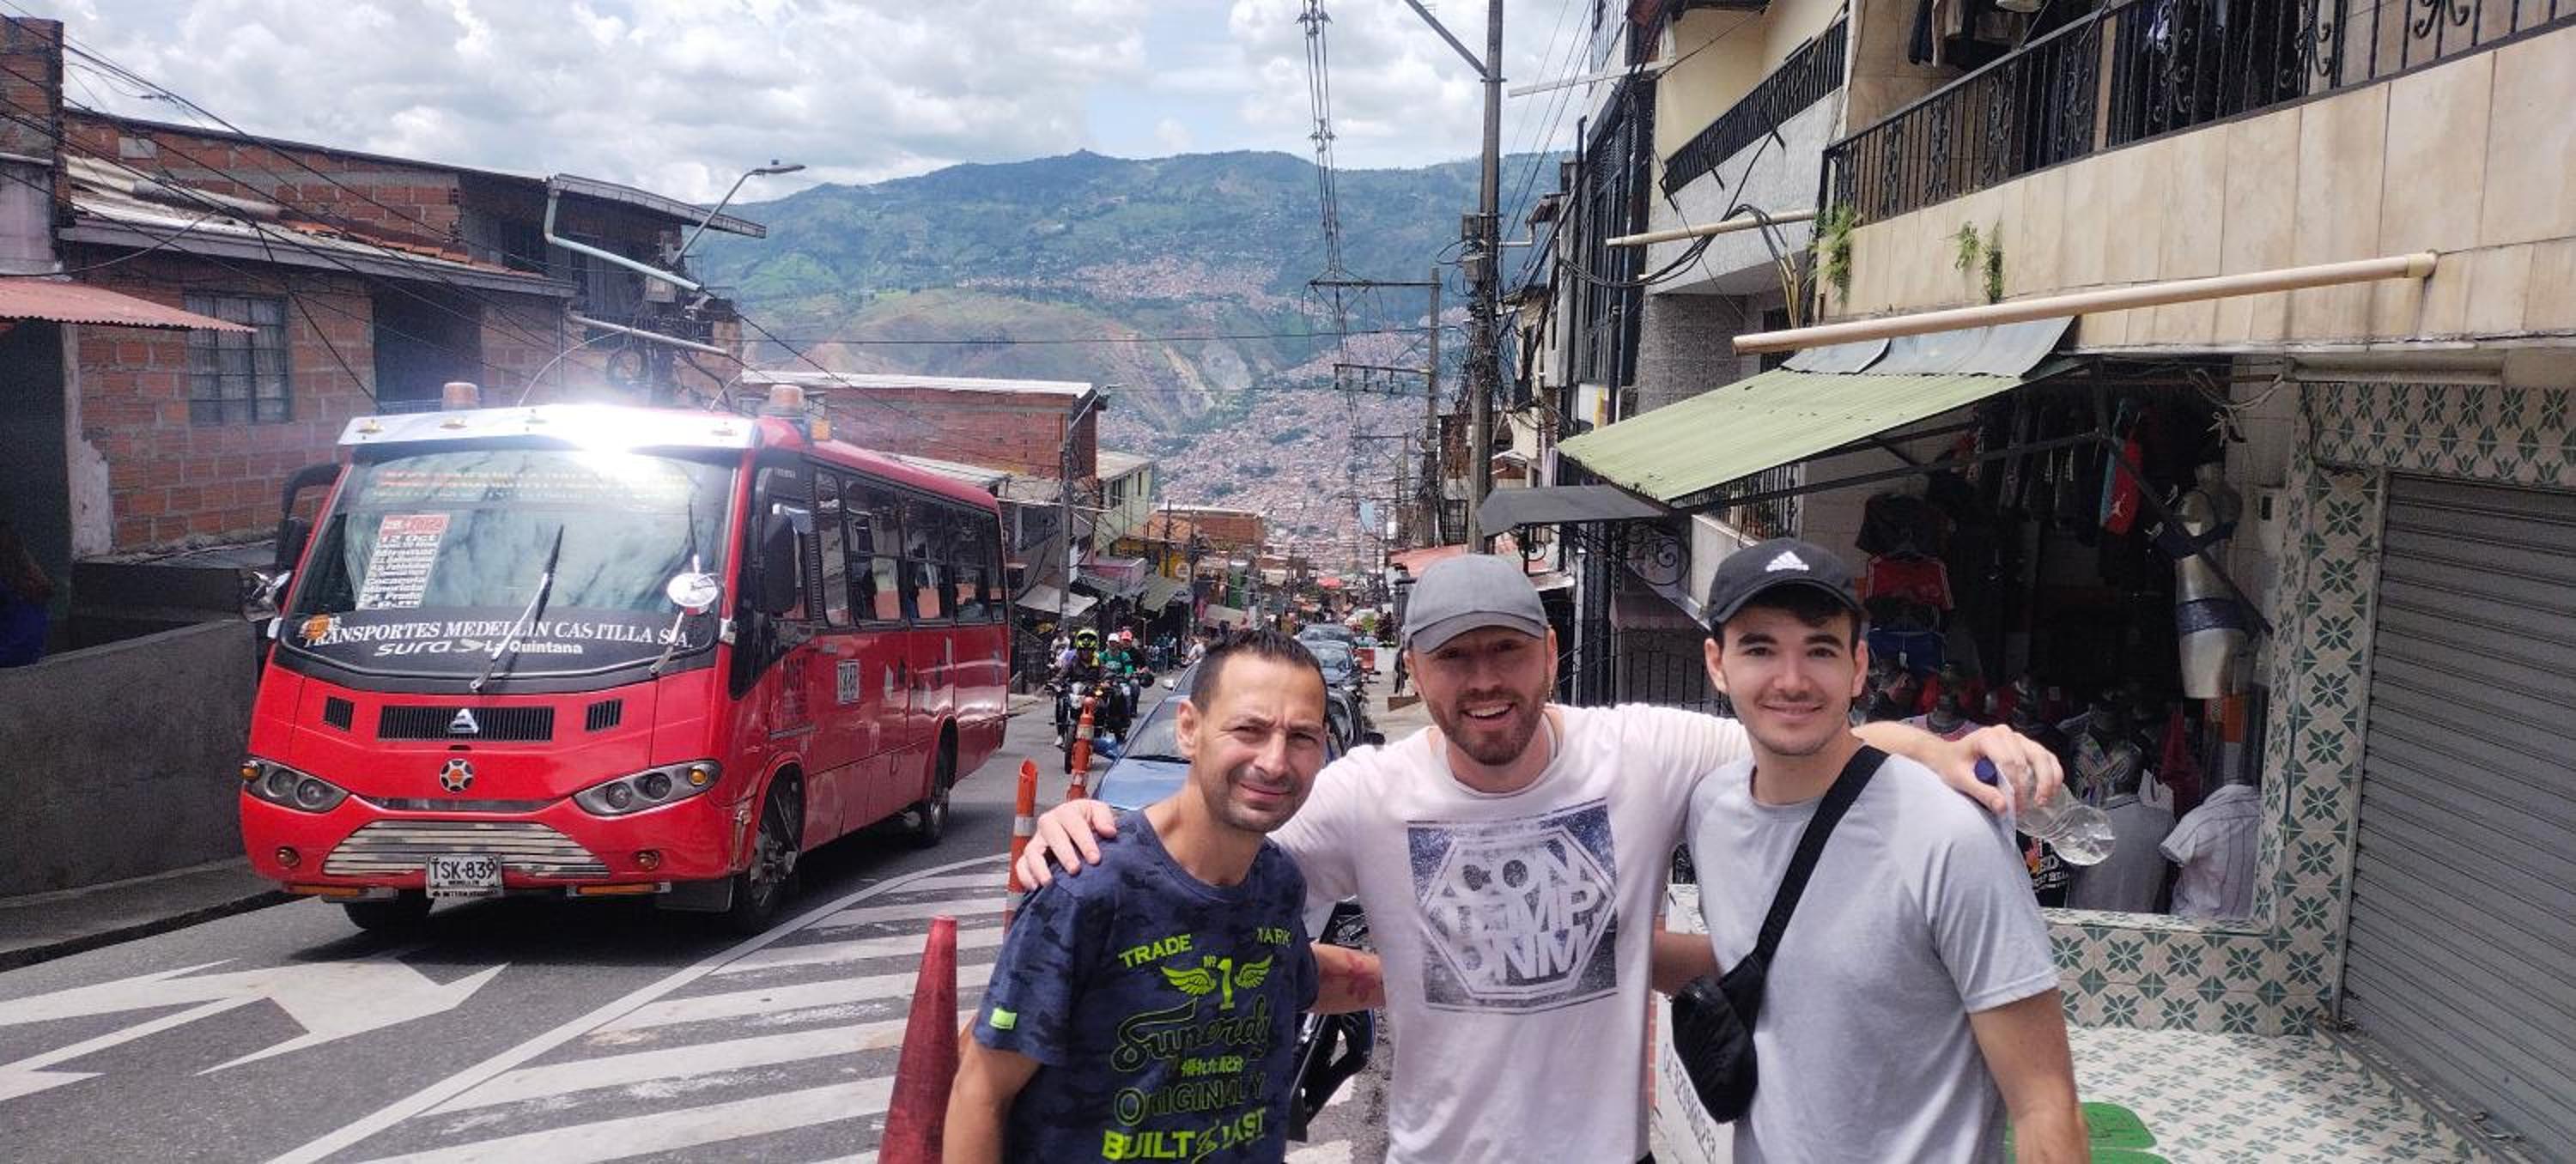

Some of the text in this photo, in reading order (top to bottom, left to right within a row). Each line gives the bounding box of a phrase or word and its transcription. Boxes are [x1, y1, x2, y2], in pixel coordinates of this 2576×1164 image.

[304, 621, 442, 647] RANSPORTES
[509, 640, 583, 655] Quintana
[1118, 934, 1193, 968] TRADE
[1102, 1129, 1196, 1160] BUILT
